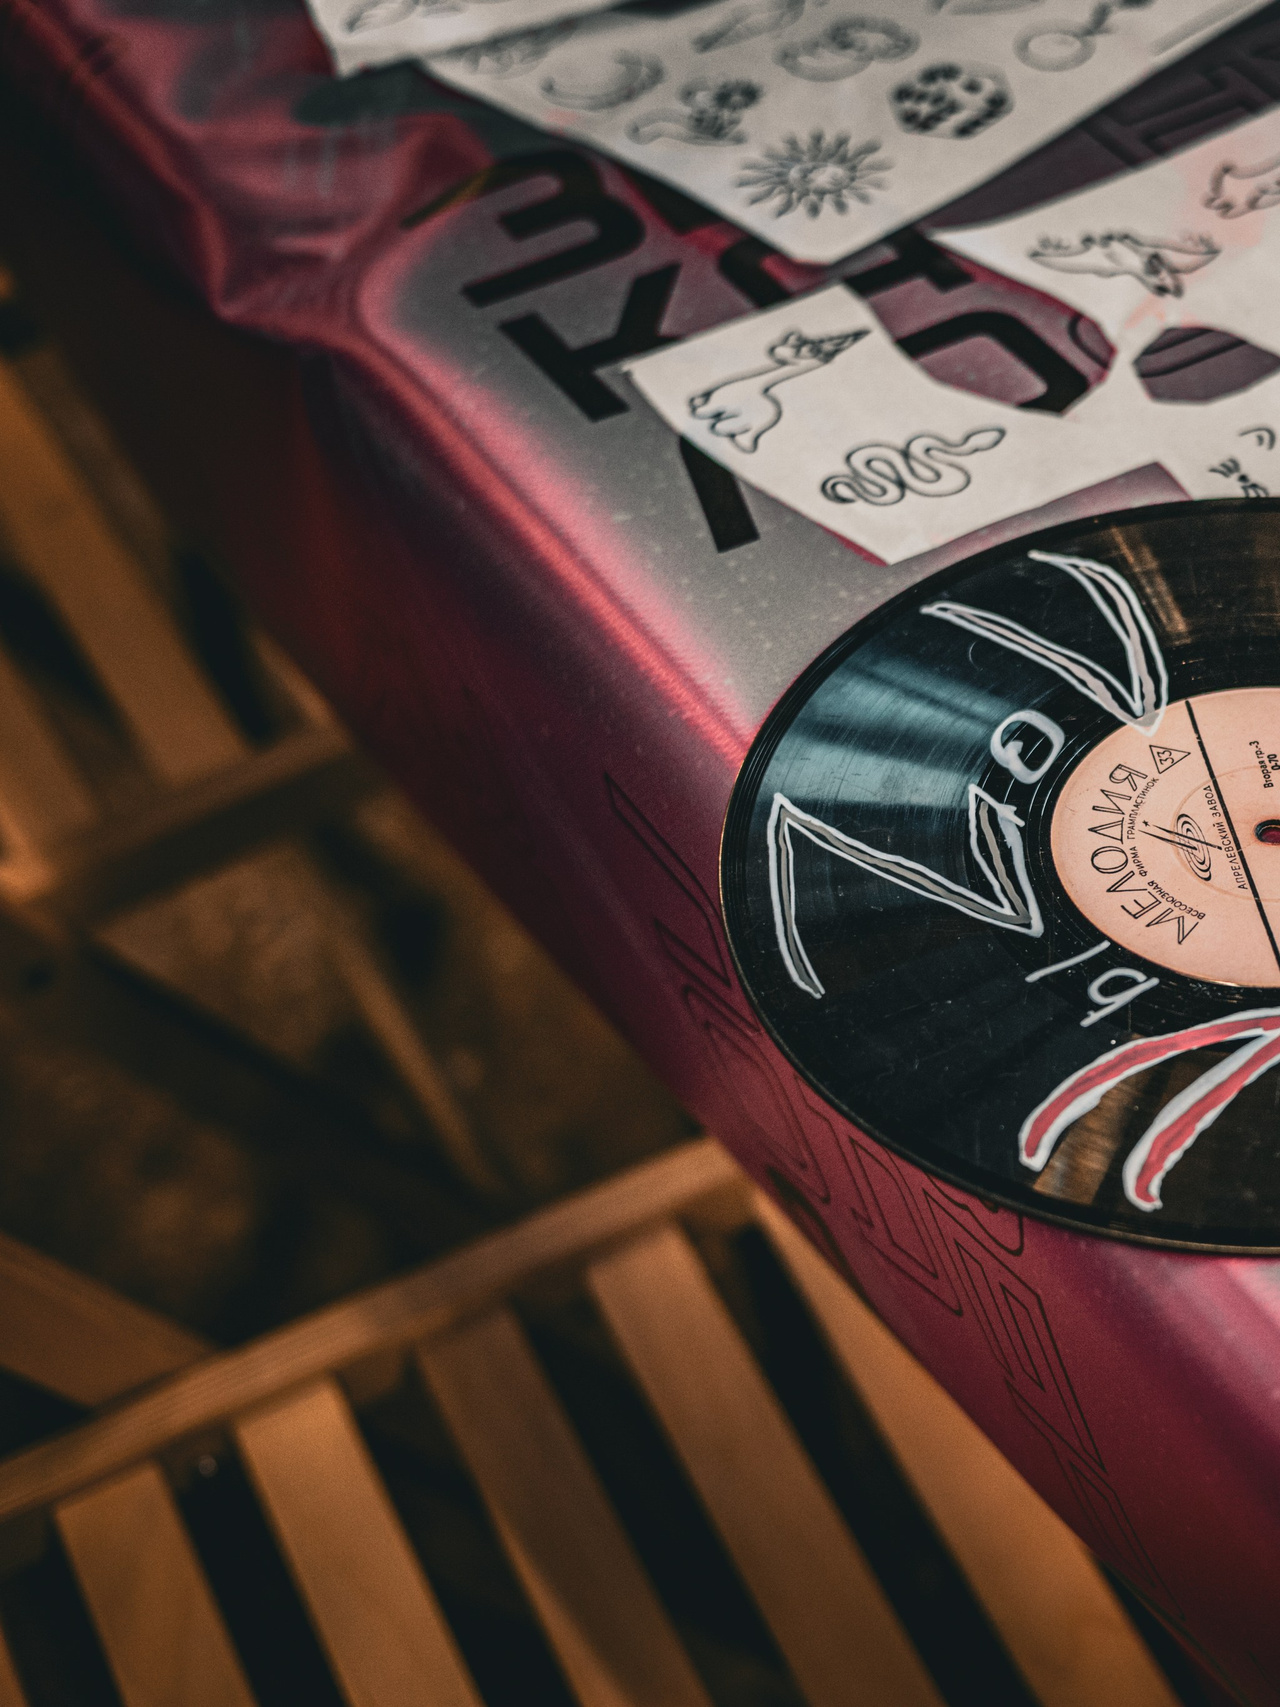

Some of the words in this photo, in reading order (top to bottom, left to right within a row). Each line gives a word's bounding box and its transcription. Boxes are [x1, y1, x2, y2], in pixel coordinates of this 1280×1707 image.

[1156, 750, 1175, 766] 33
[1258, 760, 1274, 789] Вторая
[1126, 777, 1160, 840] ГРАМПЛАСТИНОК
[1203, 785, 1221, 818] ЗАВОД
[1088, 763, 1200, 945] МЕЛОДИЯ
[1129, 846, 1148, 877] ФИРМА
[1213, 821, 1248, 890] АПРЕЛЕВСКИЙ
[1147, 880, 1206, 920] ВСЕСОЮЗНАЯ
